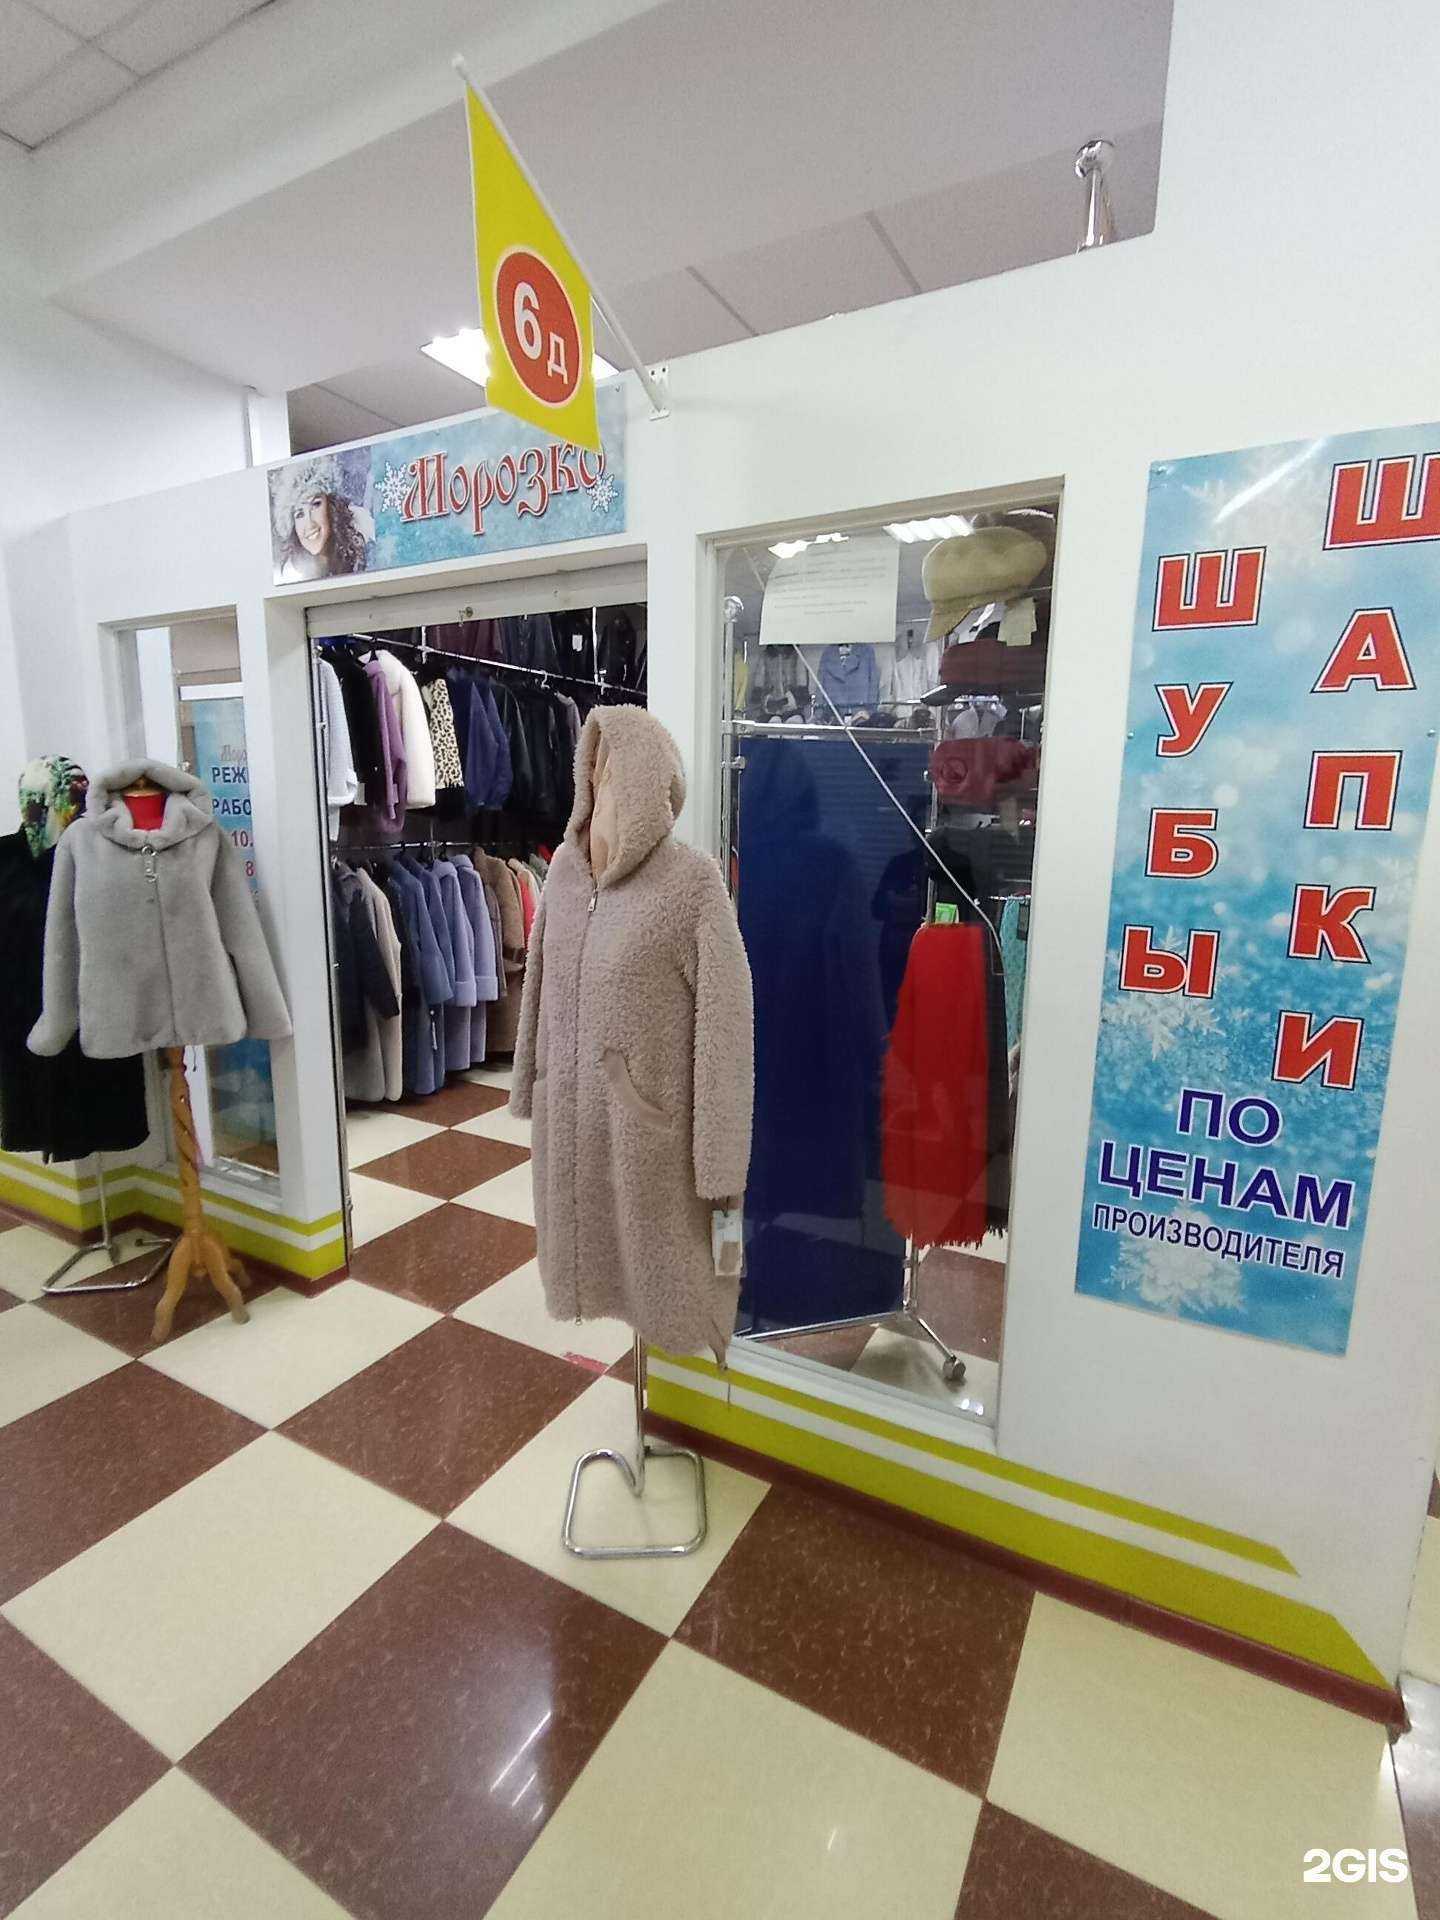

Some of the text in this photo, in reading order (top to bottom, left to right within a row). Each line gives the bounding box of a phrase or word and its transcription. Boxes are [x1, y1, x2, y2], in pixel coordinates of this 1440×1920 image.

[400, 440, 606, 536] Морозко
[1177, 1089, 1282, 1146] ПО
[1098, 1141, 1355, 1231] ЦЕНАМ
[1092, 1203, 1346, 1279] ПРОИЗВОДИТЕЛЯ
